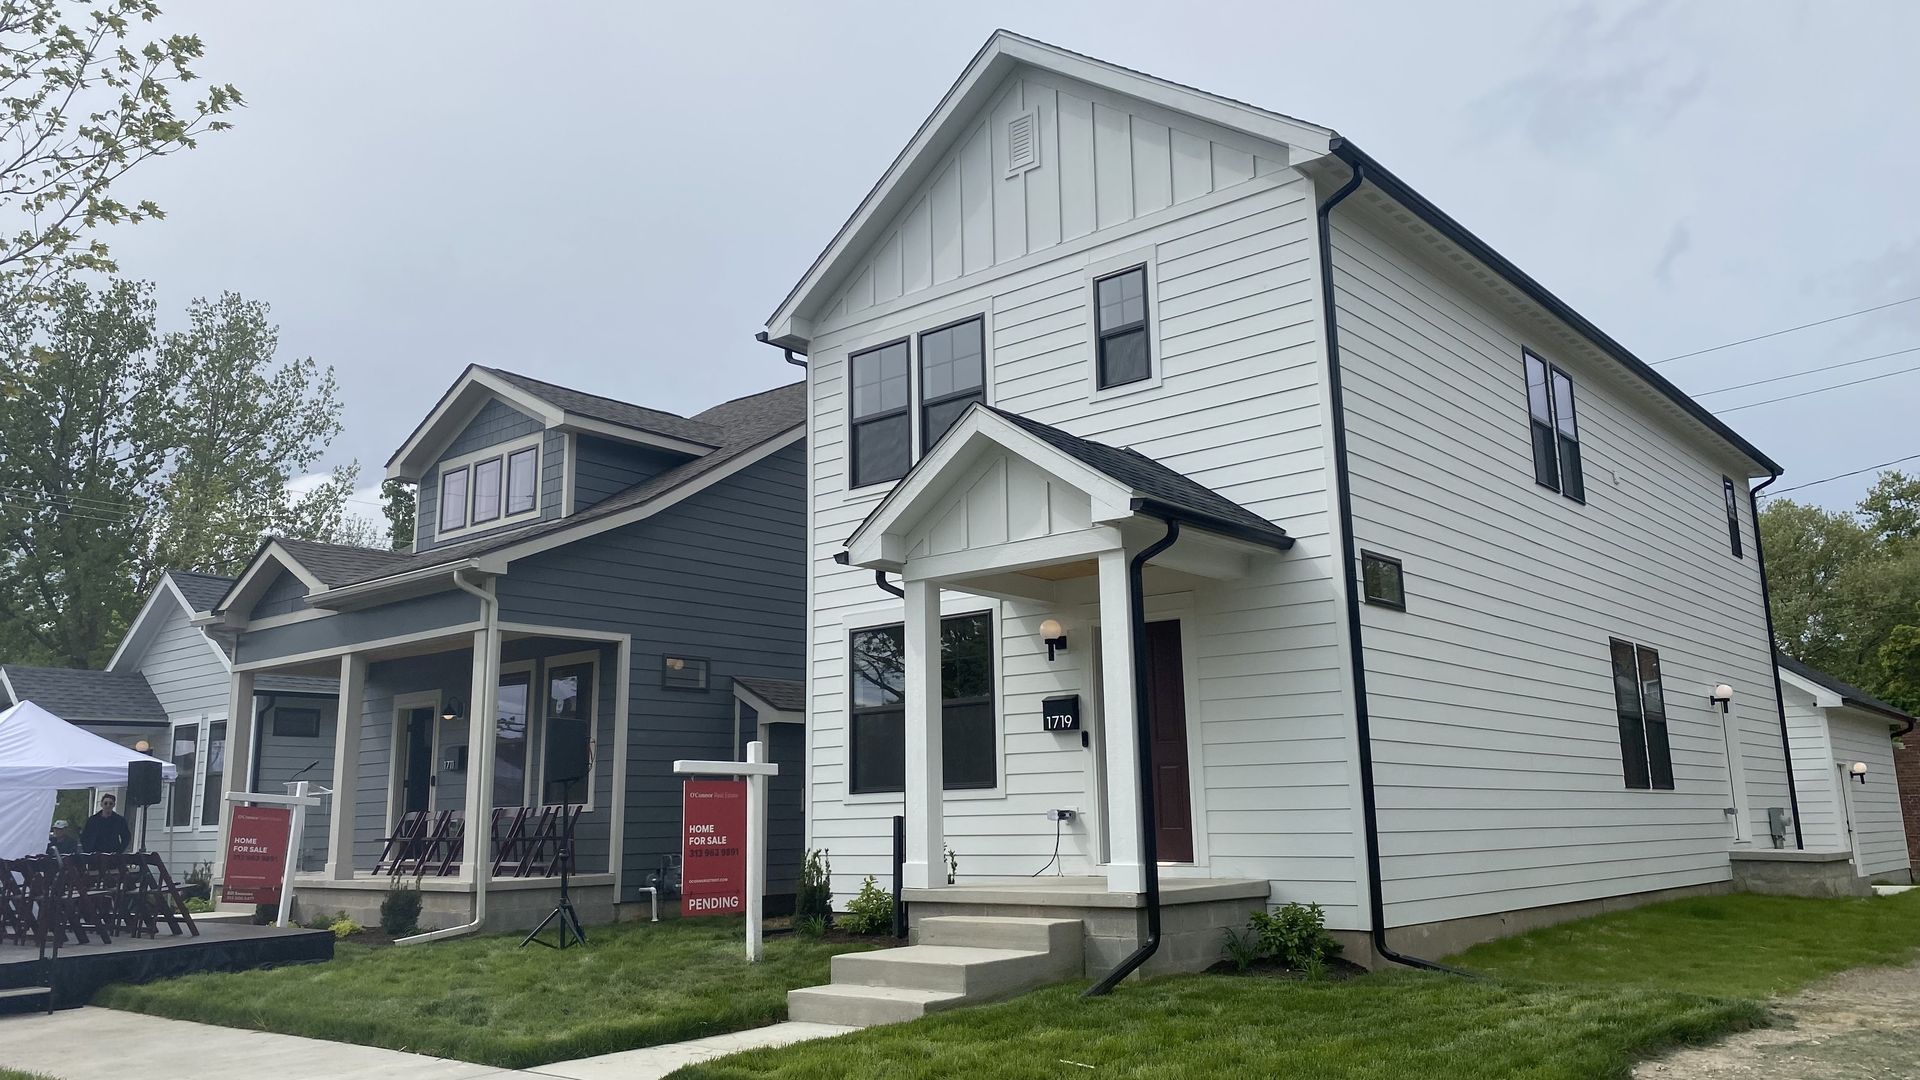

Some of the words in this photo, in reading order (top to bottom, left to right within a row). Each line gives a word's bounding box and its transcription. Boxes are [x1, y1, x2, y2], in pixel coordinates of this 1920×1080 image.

[1046, 714, 1072, 729] 1719
[689, 824, 714, 833] HOME
[689, 837, 706, 846] FOR
[707, 836, 727, 845] SALE
[249, 846, 268, 854] SALE
[689, 896, 739, 911] PENDING
